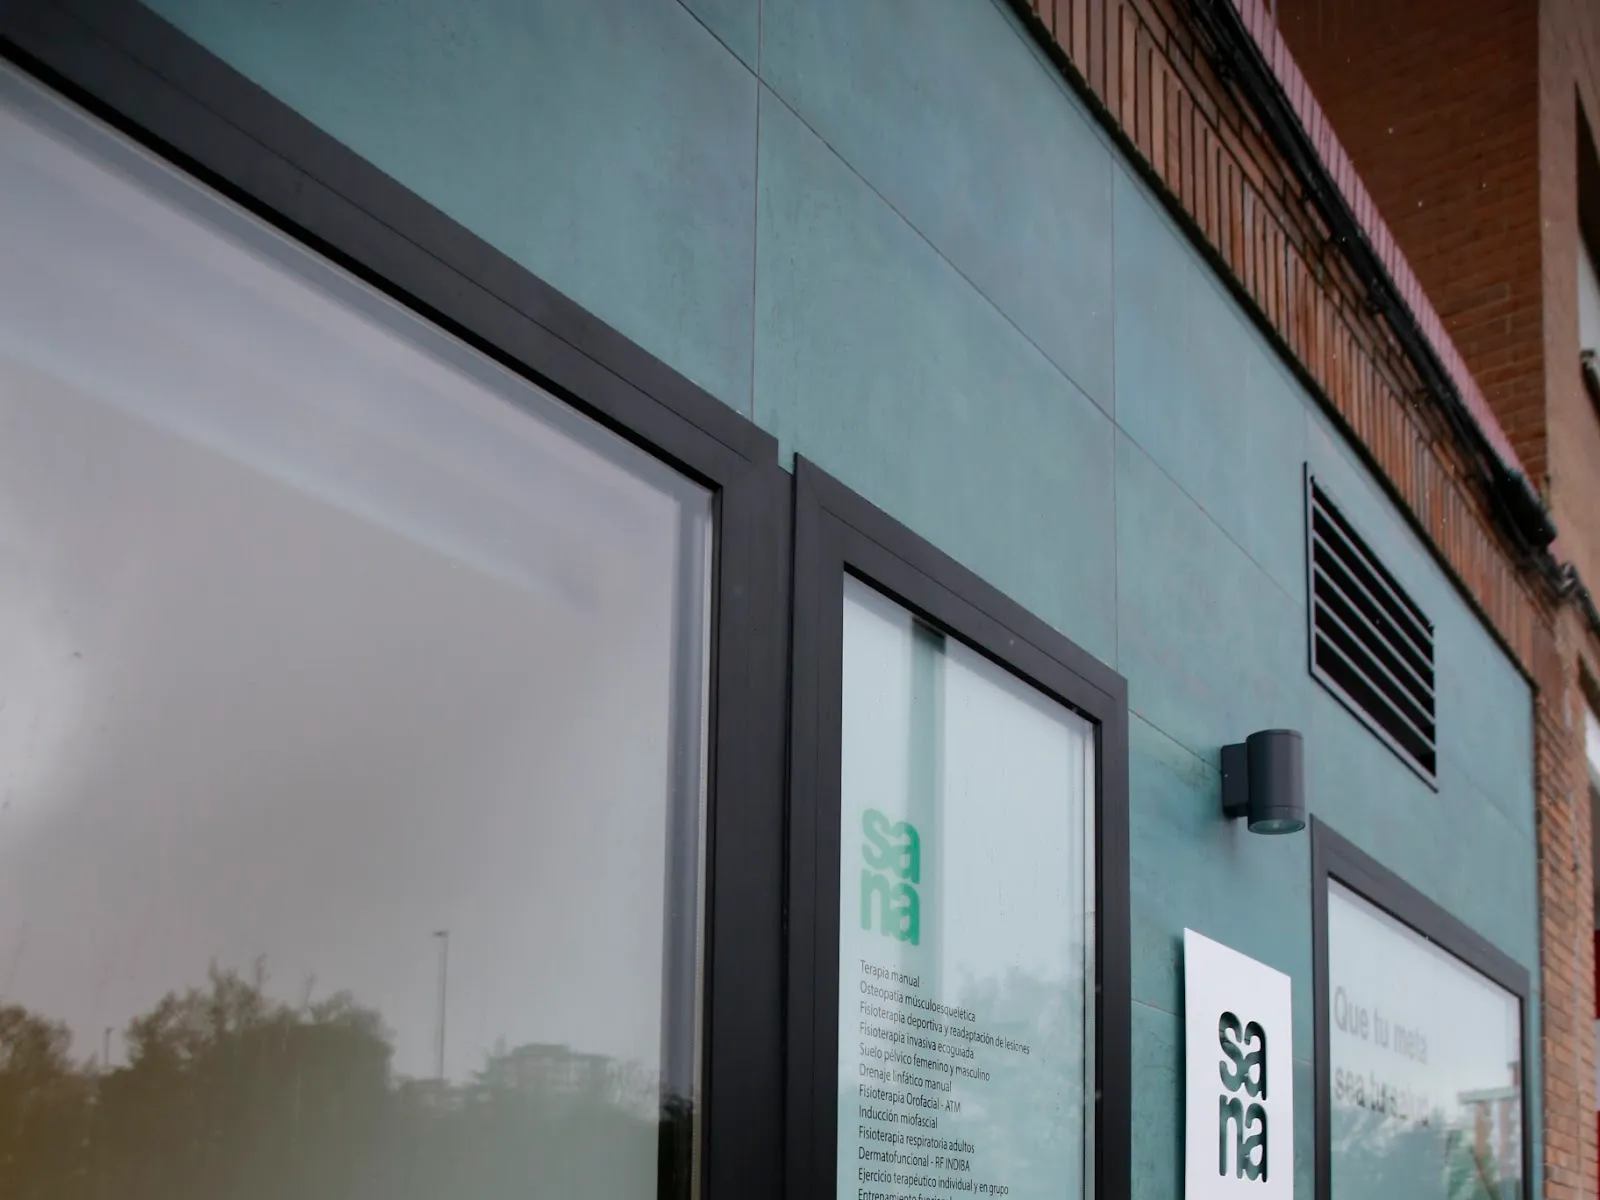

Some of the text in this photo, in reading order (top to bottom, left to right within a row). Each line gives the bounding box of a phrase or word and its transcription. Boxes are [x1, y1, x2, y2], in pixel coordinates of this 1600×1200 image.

[860, 959, 920, 988] Terapia manual
[860, 1001, 905, 1025] Fisioterapia
[907, 1013, 943, 1034] deportiva
[950, 1025, 994, 1046] readaptación
[995, 1037, 1004, 1049] de
[1334, 985, 1369, 1041] Que
[1374, 1005, 1389, 1049] tu
[860, 1022, 975, 1060] Fisioterapia invasiva ecoguiada
[1219, 1011, 1267, 1101] sa
[860, 1043, 883, 1059] Suelo
[884, 1047, 912, 1065] pélvico
[913, 1053, 948, 1073] femenino
[956, 1065, 990, 1082] masculino
[859, 1064, 952, 1092] Drenaje linfático manual
[859, 1084, 905, 1106] Fisioterapia
[906, 1092, 939, 1110] Orofacial
[945, 1100, 961, 1113] ATM
[859, 1105, 938, 1129] Inducción miofascial
[859, 1126, 975, 1154] Fisioterapia respiratoria adultos
[1219, 1094, 1268, 1183] na
[858, 1147, 929, 1168] Dermatofuncional
[935, 1156, 945, 1169] RF
[945, 1157, 971, 1172] INDIBA
[858, 1167, 892, 1184] Ejercicio
[893, 1171, 937, 1188] terapéutico
[938, 1176, 972, 1192] individual
[979, 1182, 988, 1193] en
[989, 1184, 1009, 1197] grupo
